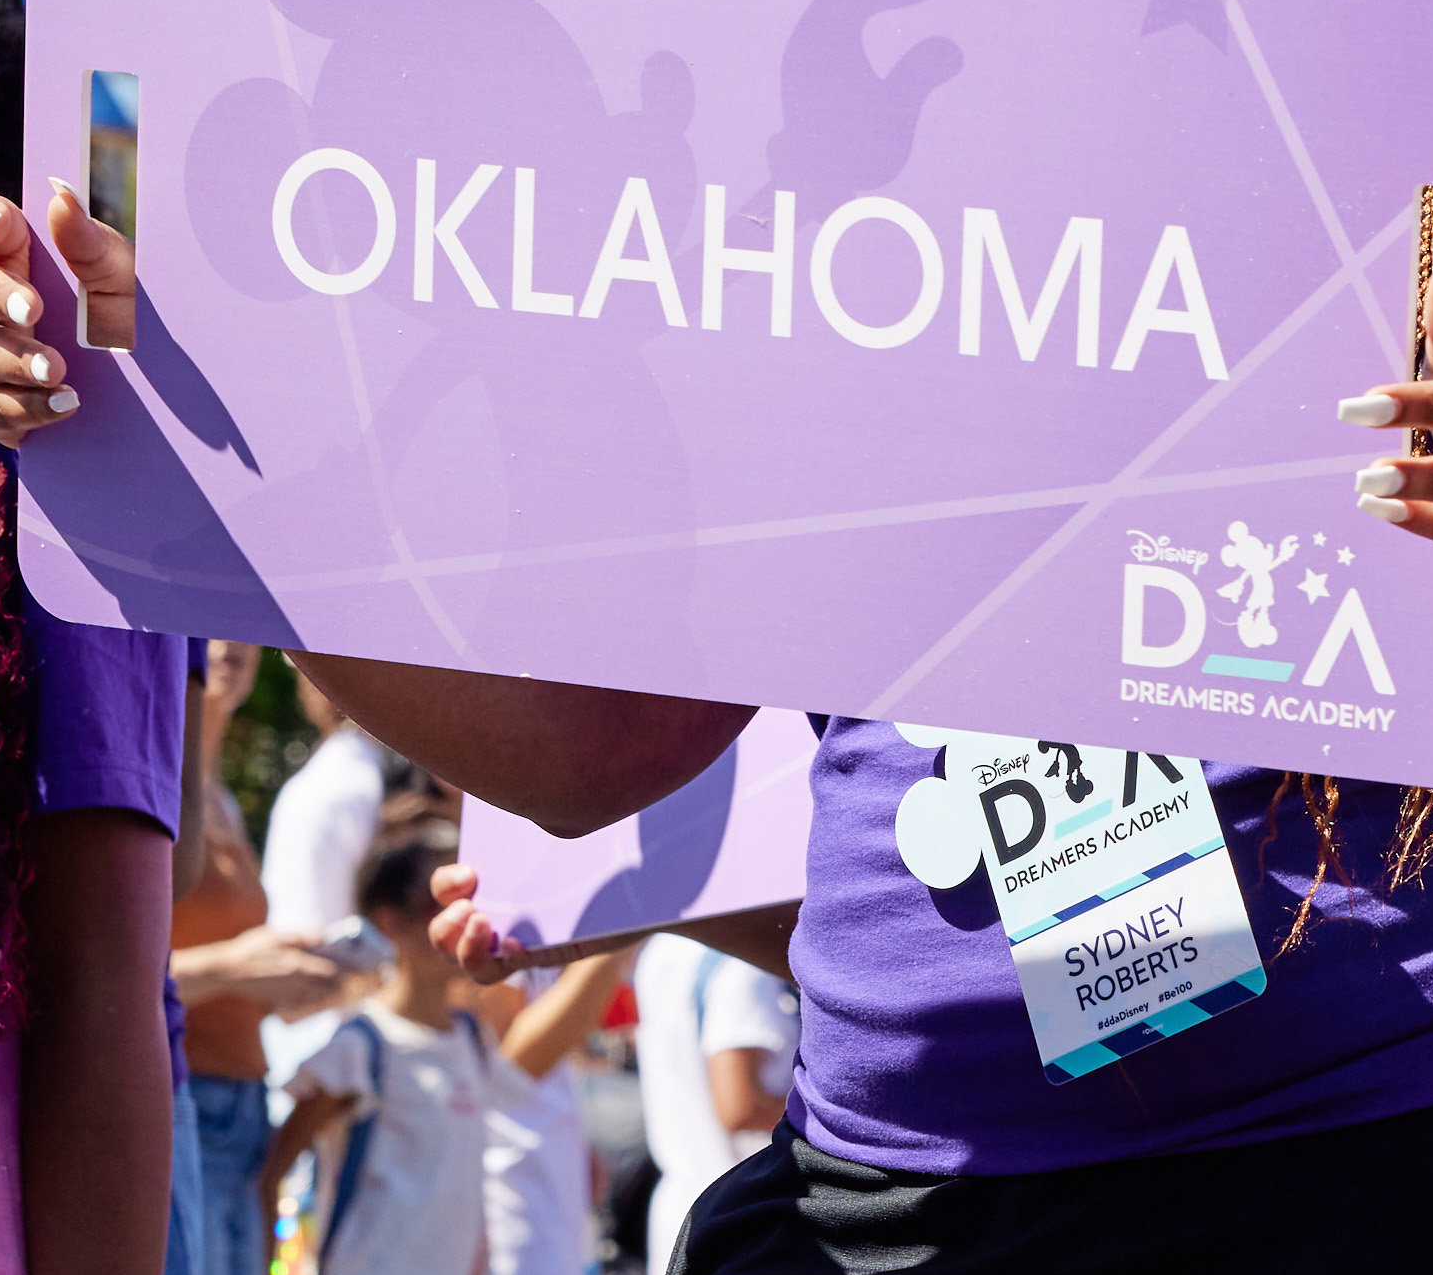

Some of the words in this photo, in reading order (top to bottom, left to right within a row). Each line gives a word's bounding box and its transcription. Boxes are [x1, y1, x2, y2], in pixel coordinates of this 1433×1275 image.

[272, 146, 1230, 382] OKLAHOMA
[1125, 529, 1209, 575] Disney
[1120, 678, 1256, 716] DREAMERS
[1260, 695, 1397, 732] ACADEMY
[971, 753, 1031, 787] Disney
[1004, 837, 1098, 894] DREAMERS
[1103, 790, 1191, 849] ACADEMY
[1064, 897, 1185, 977] SYDNEY
[1075, 936, 1199, 1011] ROBERTS
[1096, 1001, 1150, 1031] #ddaDisney
[1157, 980, 1194, 1004] #Be100
